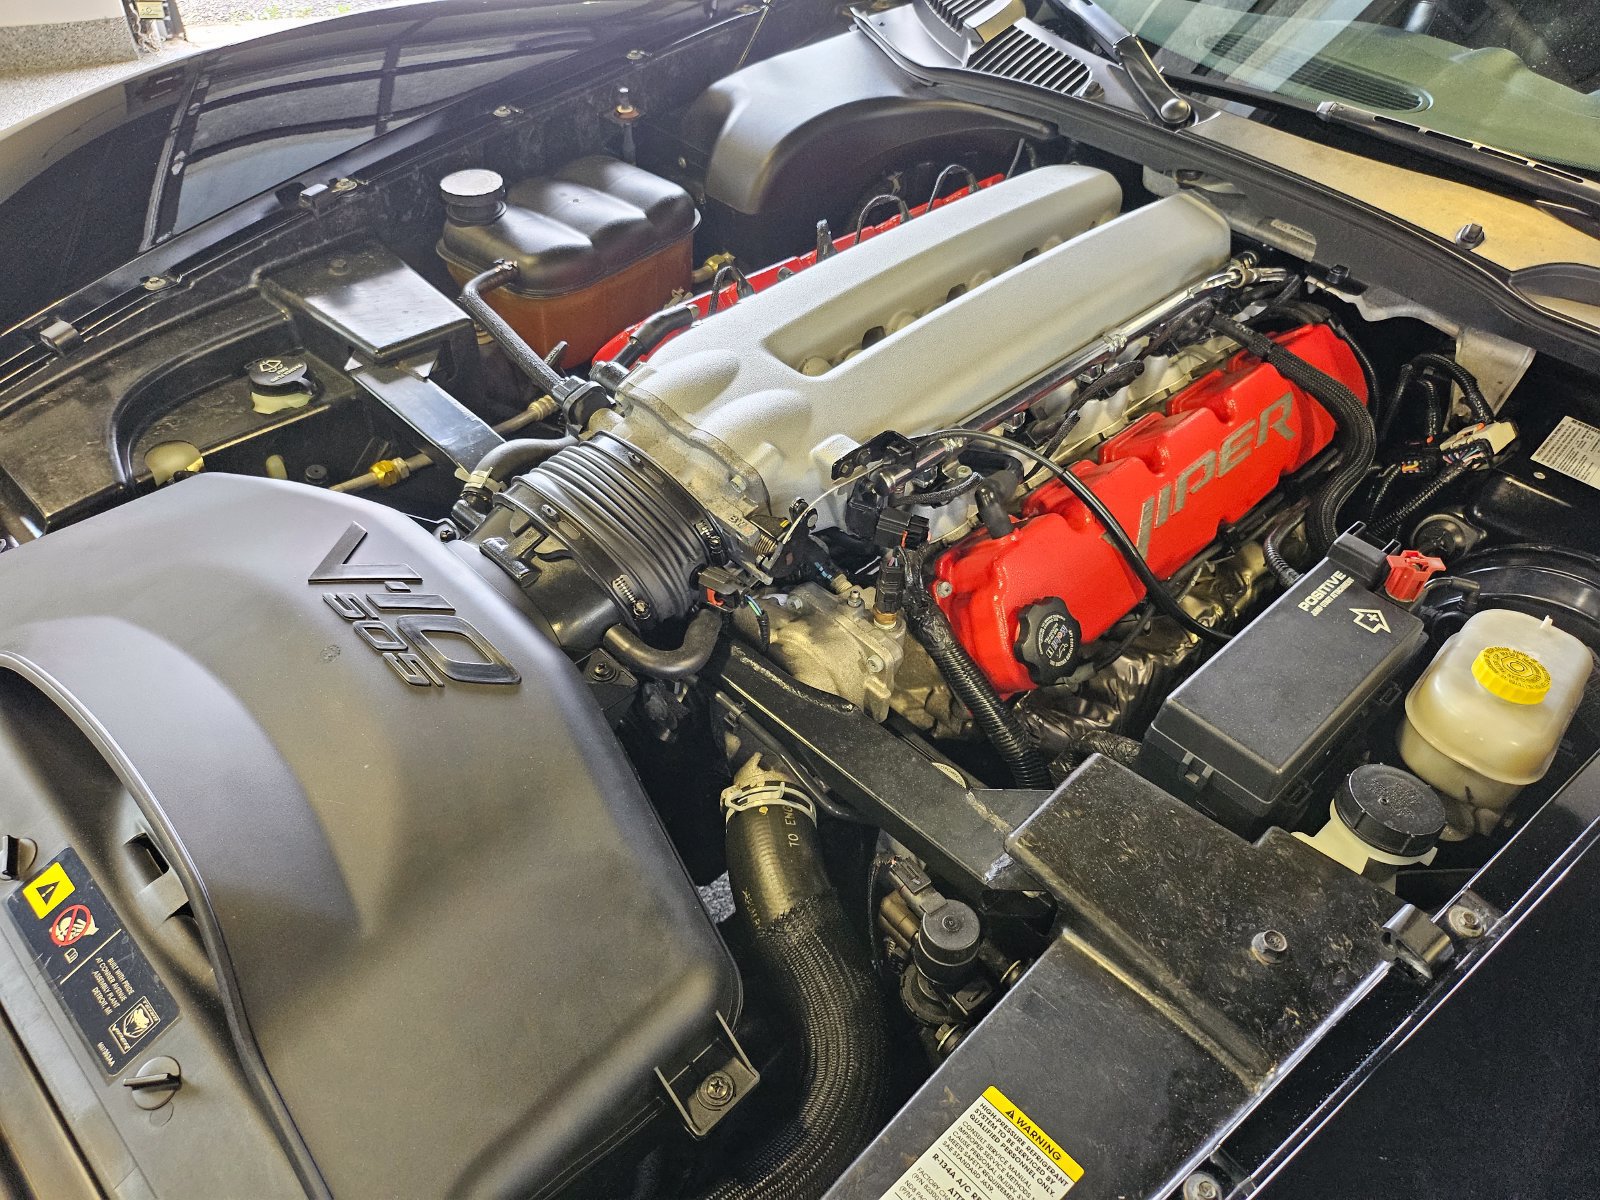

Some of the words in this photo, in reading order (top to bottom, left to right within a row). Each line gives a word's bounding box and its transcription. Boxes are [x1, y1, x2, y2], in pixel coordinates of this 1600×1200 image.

[1298, 570, 1346, 612] POSITIVE
[322, 592, 445, 687] 505
[788, 833, 800, 848] TO
[92, 969, 111, 993] ASSEMBLY
[108, 992, 120, 1008] PLANT
[95, 956, 103, 964] AT
[99, 962, 116, 984] CONNER
[111, 982, 127, 1002] AVENUE
[106, 957, 118, 970] BUILT
[115, 969, 126, 982] WITH
[121, 980, 134, 995] PRIDE
[941, 1140, 954, 1152] SAE
[952, 1150, 981, 1179] STANDARD
[946, 1135, 964, 1152] MEETS
[962, 1151, 982, 1170] SAFETY
[951, 1130, 971, 1149] CAUSE
[969, 1147, 998, 1175] PERSONAL
[961, 1120, 987, 1144] CONSULT
[985, 1143, 1008, 1165] SERVICE
[1006, 1164, 1034, 1190] MANUAL.
[968, 1113, 1000, 1144] QUALIFIED
[999, 1142, 1037, 1178] PERSONNEL
[1035, 1177, 1056, 1197] ONLY.
[974, 1107, 997, 1130] SYSTEM
[997, 1129, 1006, 1139] TO
[1005, 1137, 1015, 1147] BE
[1014, 1145, 1046, 1176] SERVICED
[1045, 1175, 1055, 1185] BY
[979, 1102, 1026, 1147] HIGH-PRESSURE
[1024, 1145, 1068, 1187] REFRIGERANT
[1015, 1116, 1062, 1161] WARNING
[915, 1166, 941, 1191] FACTORY
[931, 1153, 958, 1179] R-134A
[955, 1176, 972, 1193] A/C
[956, 1125, 984, 1152] IMPROPER
[982, 1150, 1006, 1173] SERVICE
[1004, 1171, 1032, 1198] METHODS
